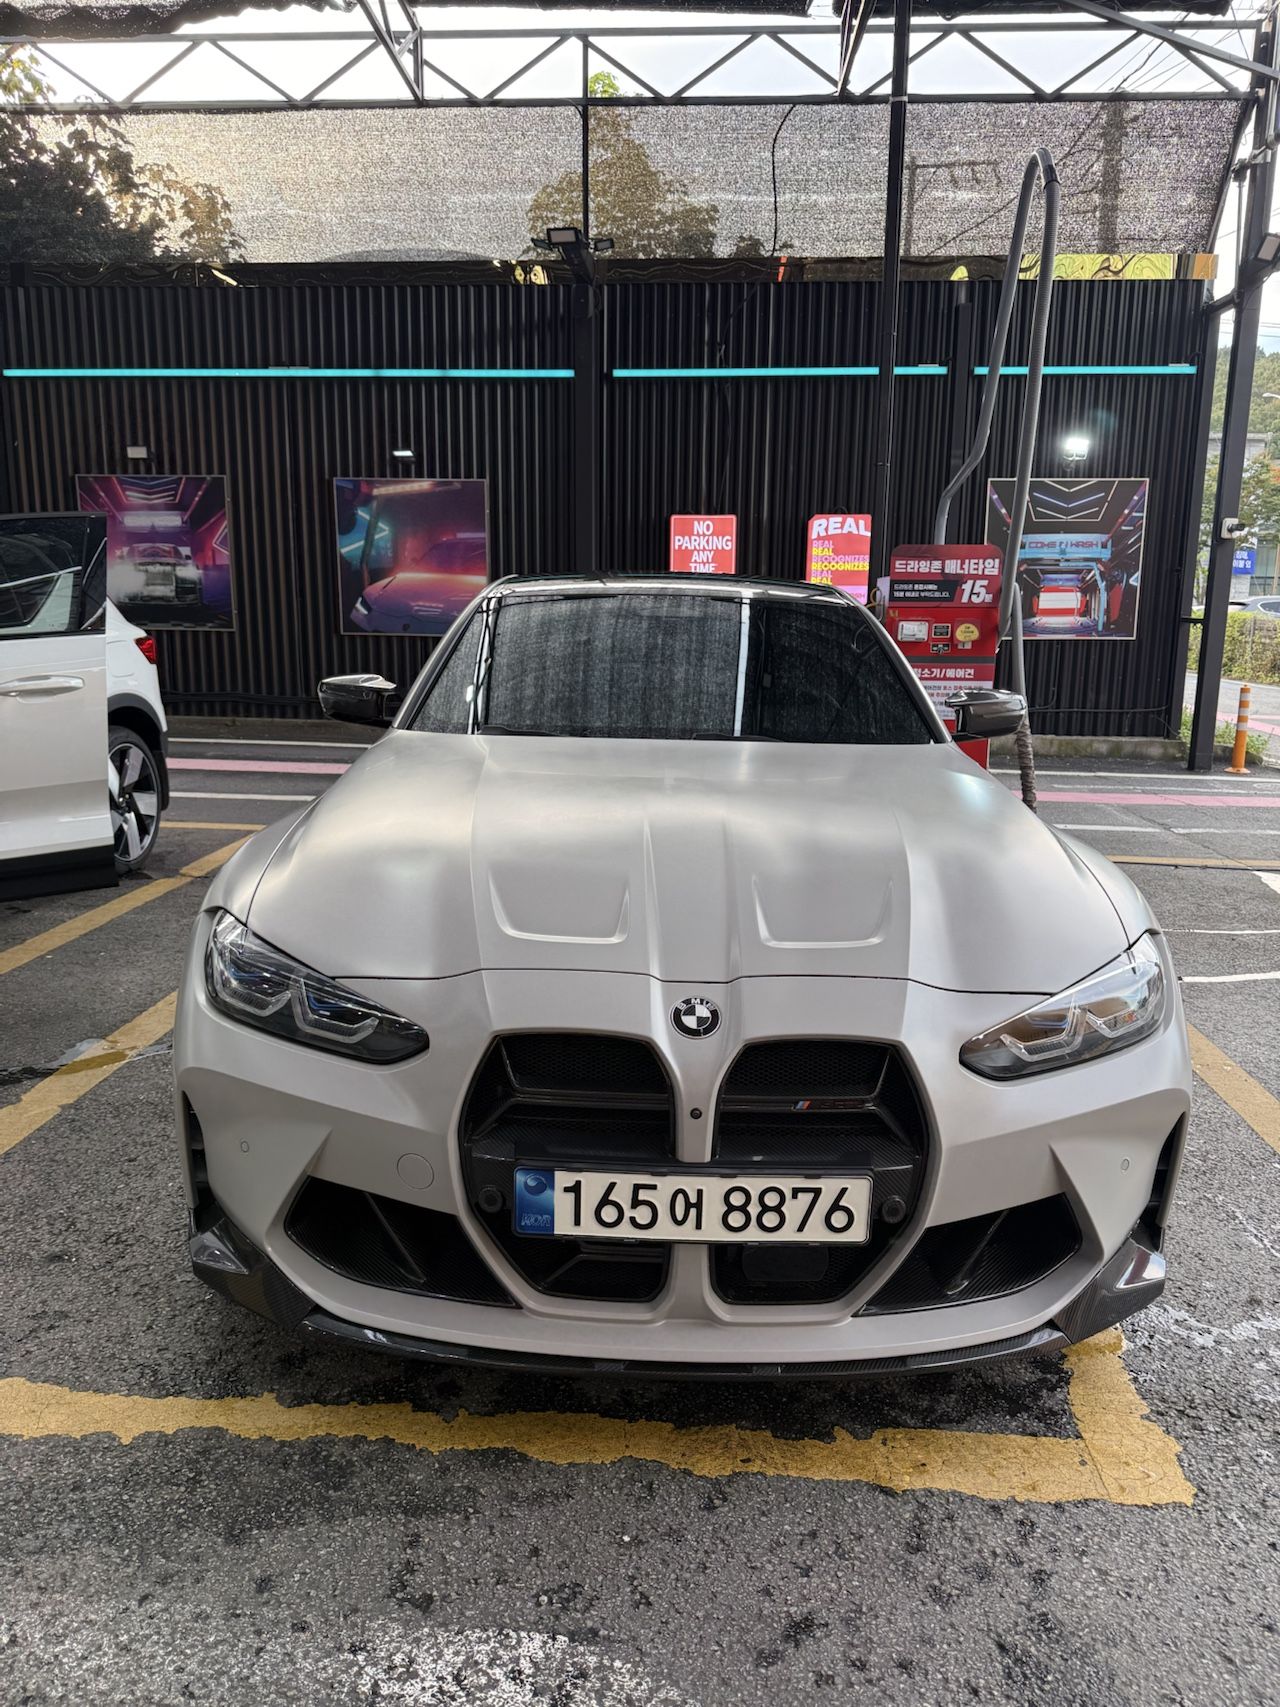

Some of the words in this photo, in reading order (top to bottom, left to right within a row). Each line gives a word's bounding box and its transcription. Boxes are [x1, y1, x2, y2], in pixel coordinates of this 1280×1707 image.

[693, 520, 714, 535] NO
[812, 516, 872, 539] REAL
[674, 535, 732, 550] PARKING
[812, 540, 834, 548] REAL
[691, 550, 714, 563] ANY
[812, 547, 834, 555] REAL
[812, 555, 870, 563] RECOGNIZES
[811, 562, 870, 571] RECOGNIZES
[895, 559, 943, 573] 드라잉존
[944, 558, 1000, 575] 매너타임
[811, 570, 832, 578] REAL
[563, 1179, 704, 1231] 165어
[720, 1185, 857, 1234] 8876
